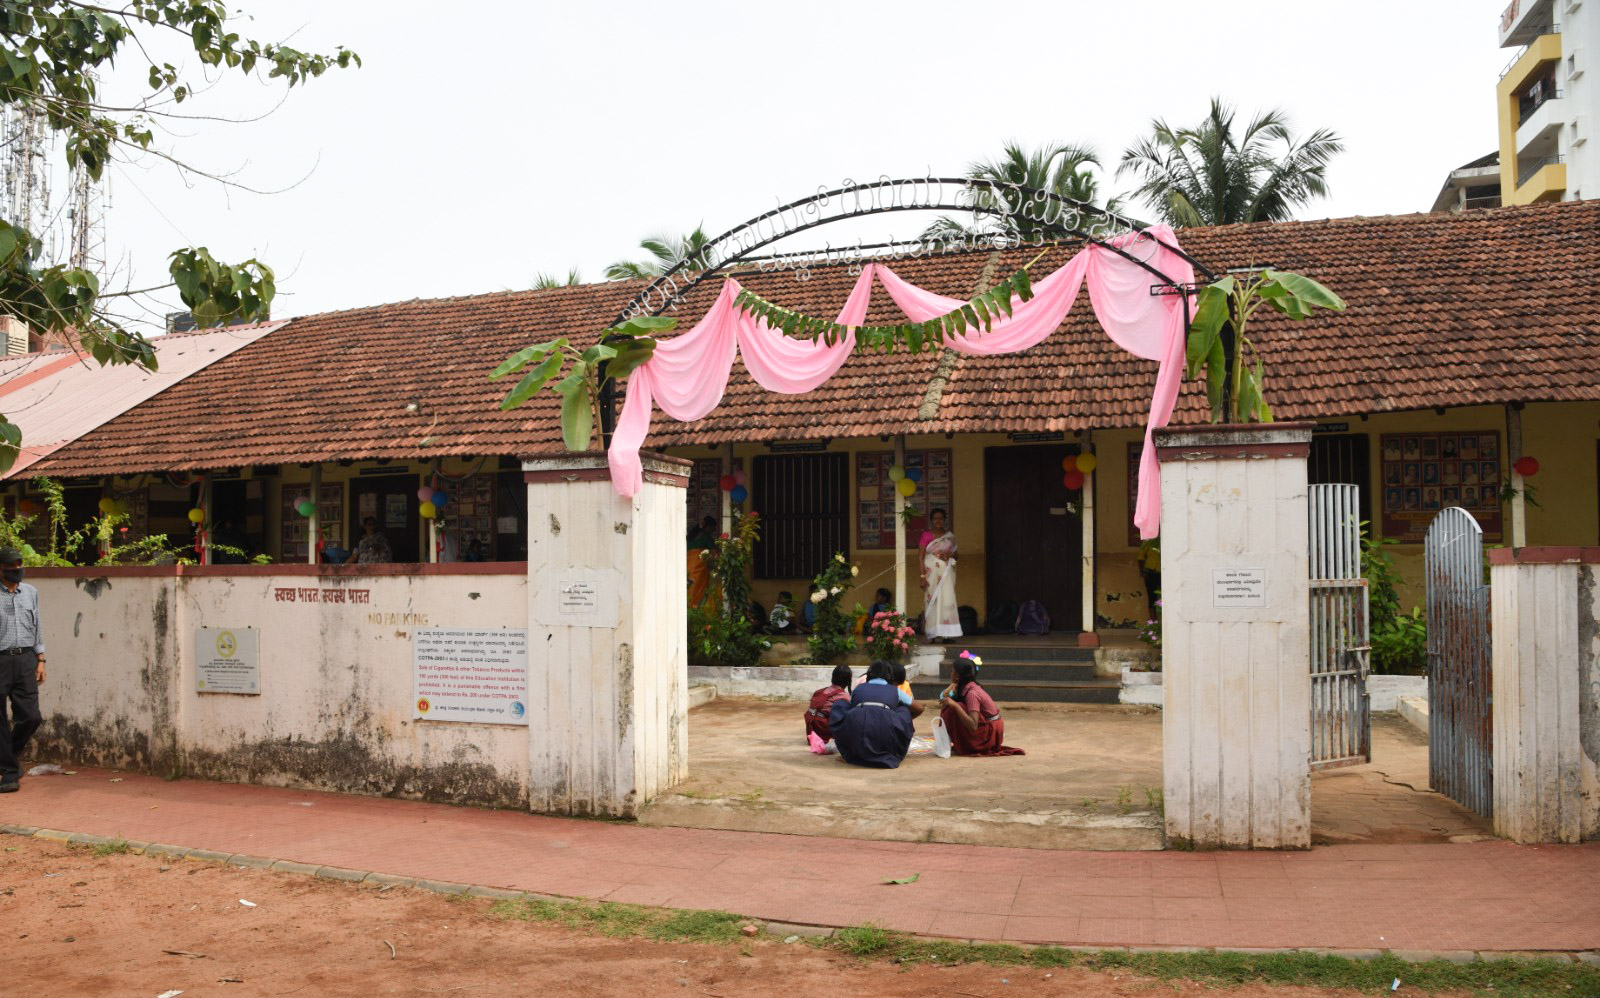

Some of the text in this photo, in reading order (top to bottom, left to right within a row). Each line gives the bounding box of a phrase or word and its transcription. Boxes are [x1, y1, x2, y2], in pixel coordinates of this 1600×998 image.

[841, 163, 942, 216] ಹಿರಿಯ
[954, 172, 1093, 231] ಪ್ರಾಥಮಿಕ
[274, 587, 296, 602] स्वच्छ
[322, 588, 346, 603] स्वस्थ
[348, 588, 370, 604] भारत
[368, 612, 382, 625] NO
